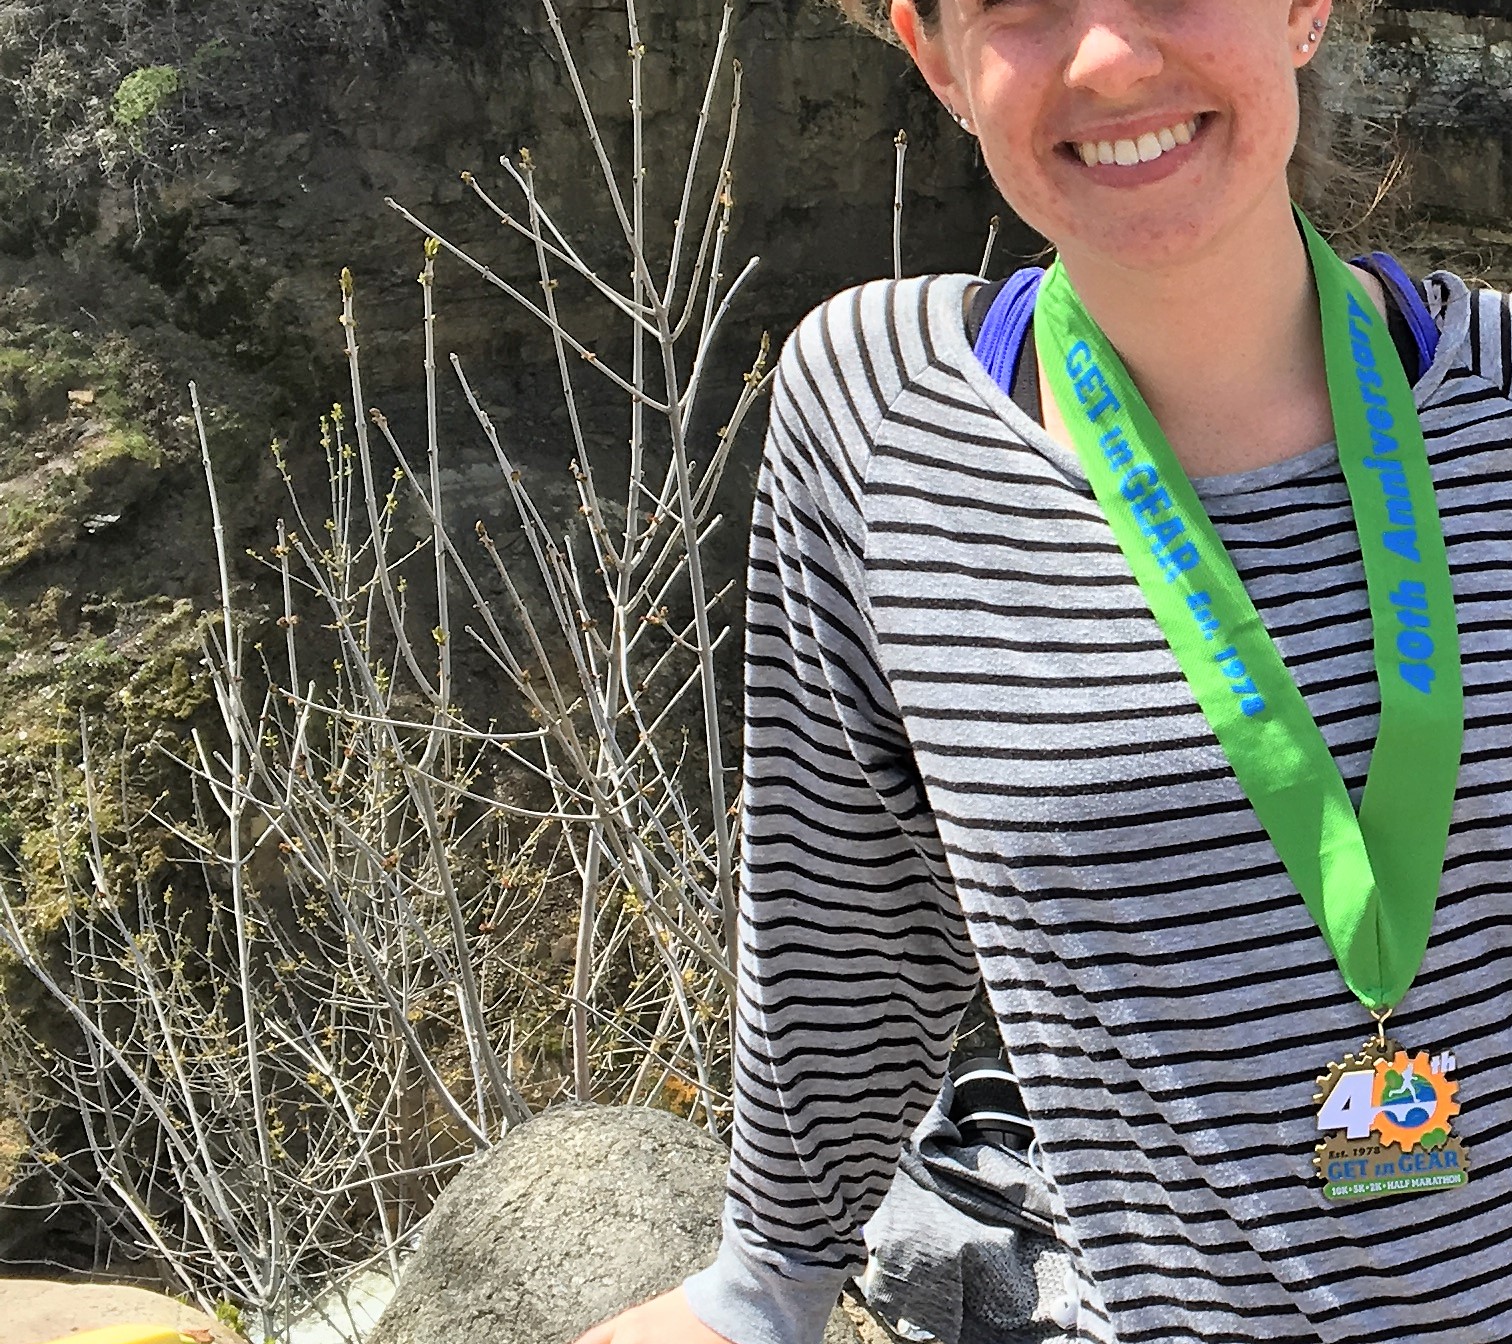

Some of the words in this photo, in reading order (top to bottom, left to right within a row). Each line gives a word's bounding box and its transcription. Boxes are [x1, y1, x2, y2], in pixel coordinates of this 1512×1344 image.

[1347, 290, 1422, 563] Anniversary
[1066, 340, 1120, 423] GET
[1099, 425, 1134, 473] in
[1120, 462, 1200, 584] GEAR
[1214, 645, 1265, 717] 1978
[1389, 581, 1436, 695] 40th
[1327, 1158, 1369, 1182] GET
[1374, 1162, 1395, 1176] in
[1397, 1150, 1460, 1174] GEAR
[1353, 1146, 1381, 1157] 1978
[1387, 1179, 1411, 1190] HALF
[1411, 1174, 1462, 1188] MARATHON
